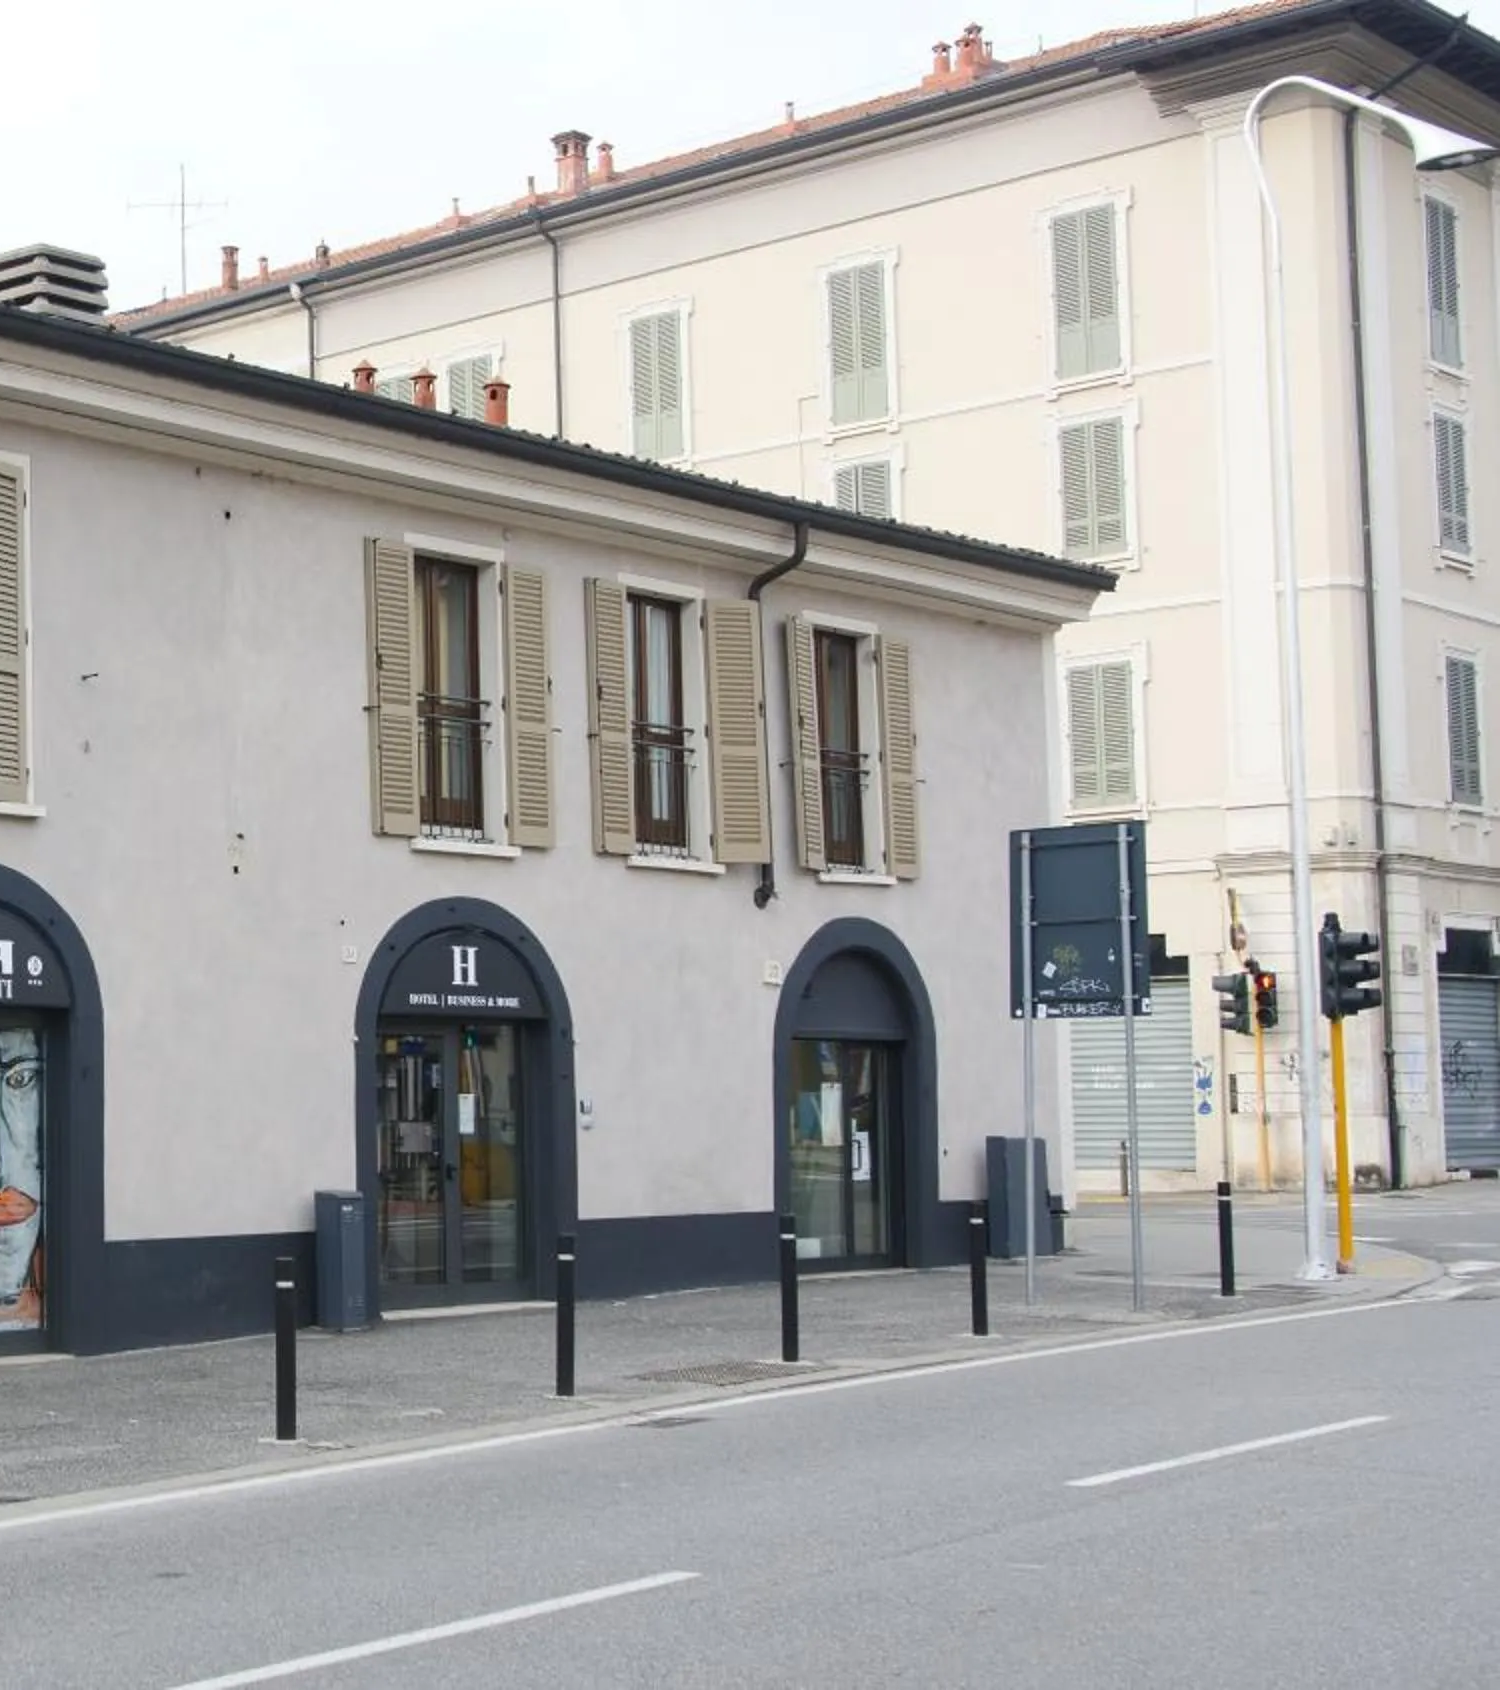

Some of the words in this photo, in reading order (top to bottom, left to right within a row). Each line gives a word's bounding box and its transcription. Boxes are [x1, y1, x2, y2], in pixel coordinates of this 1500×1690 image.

[451, 945, 479, 987] H
[409, 993, 439, 1006] HOTEL
[447, 995, 486, 1007] BUSINESS
